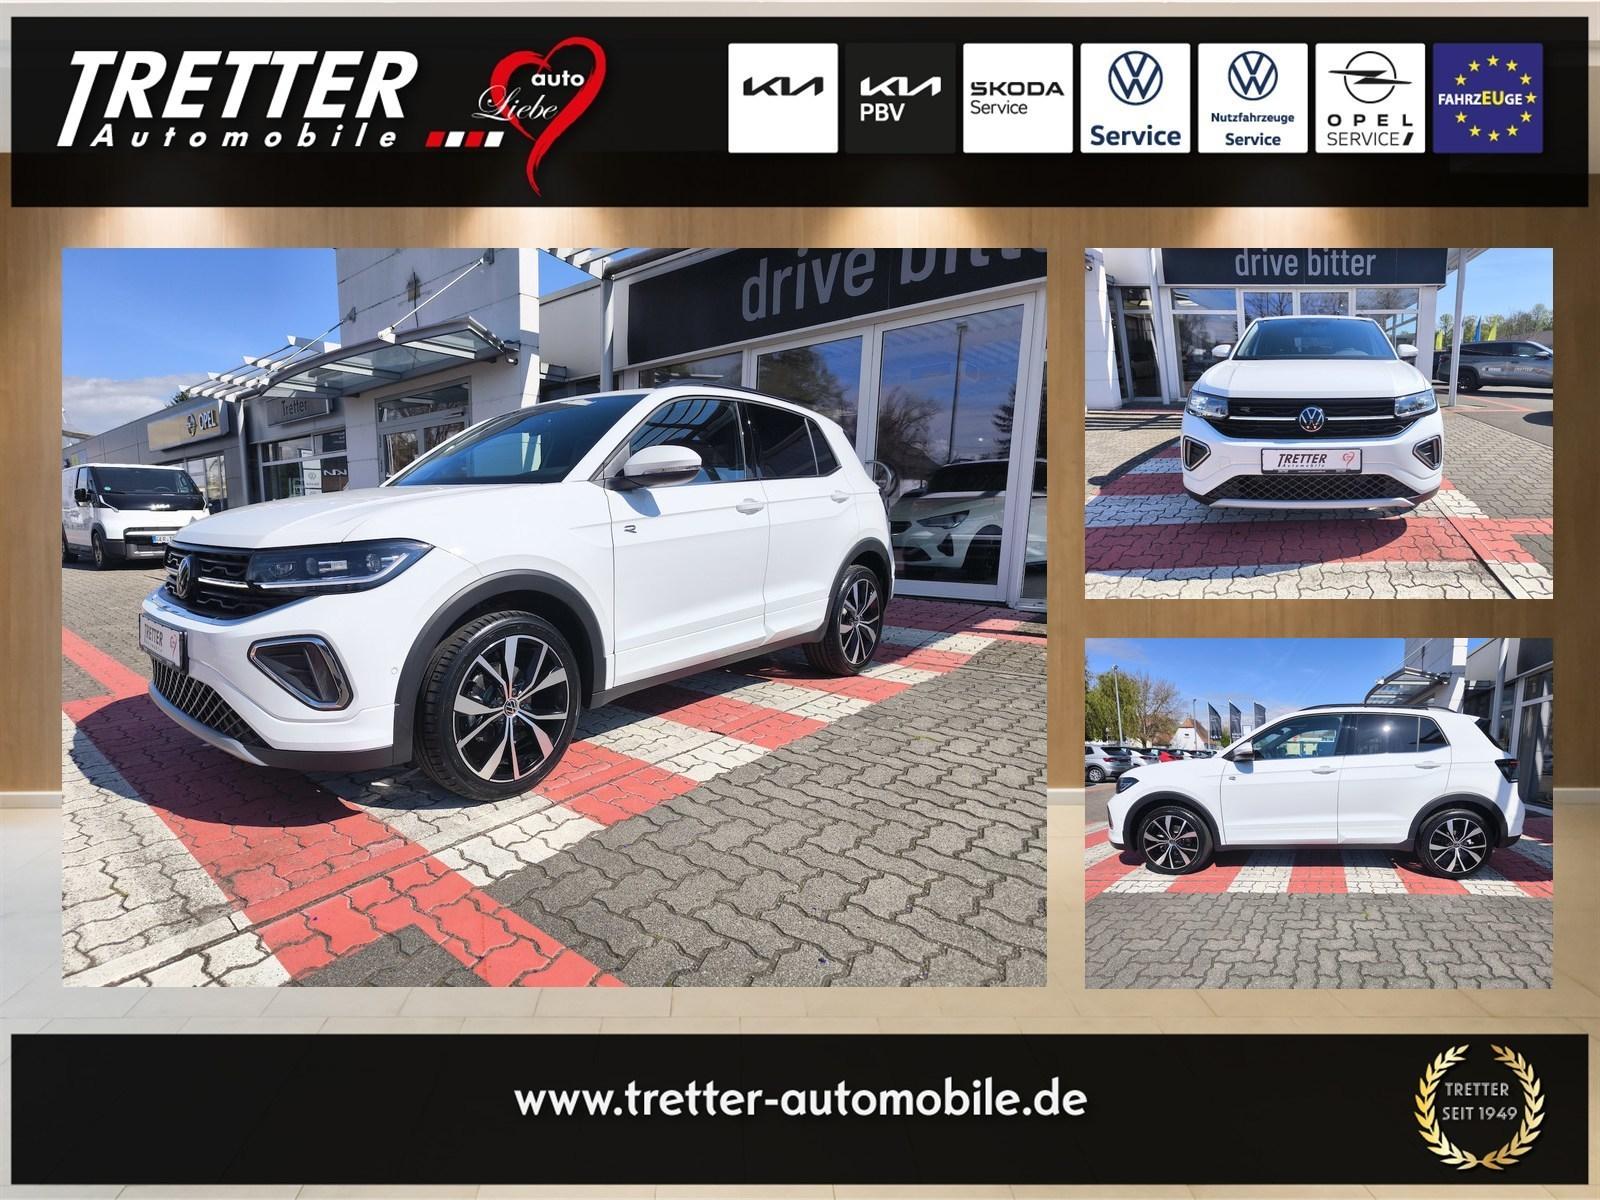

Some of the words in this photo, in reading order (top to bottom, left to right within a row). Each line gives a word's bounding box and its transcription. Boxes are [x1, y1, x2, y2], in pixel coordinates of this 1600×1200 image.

[1235, 248, 1298, 276] drive
[1308, 248, 1377, 276] bitter
[742, 248, 876, 321] drive
[199, 408, 218, 431] OPEL
[1278, 453, 1328, 467] TRETTER
